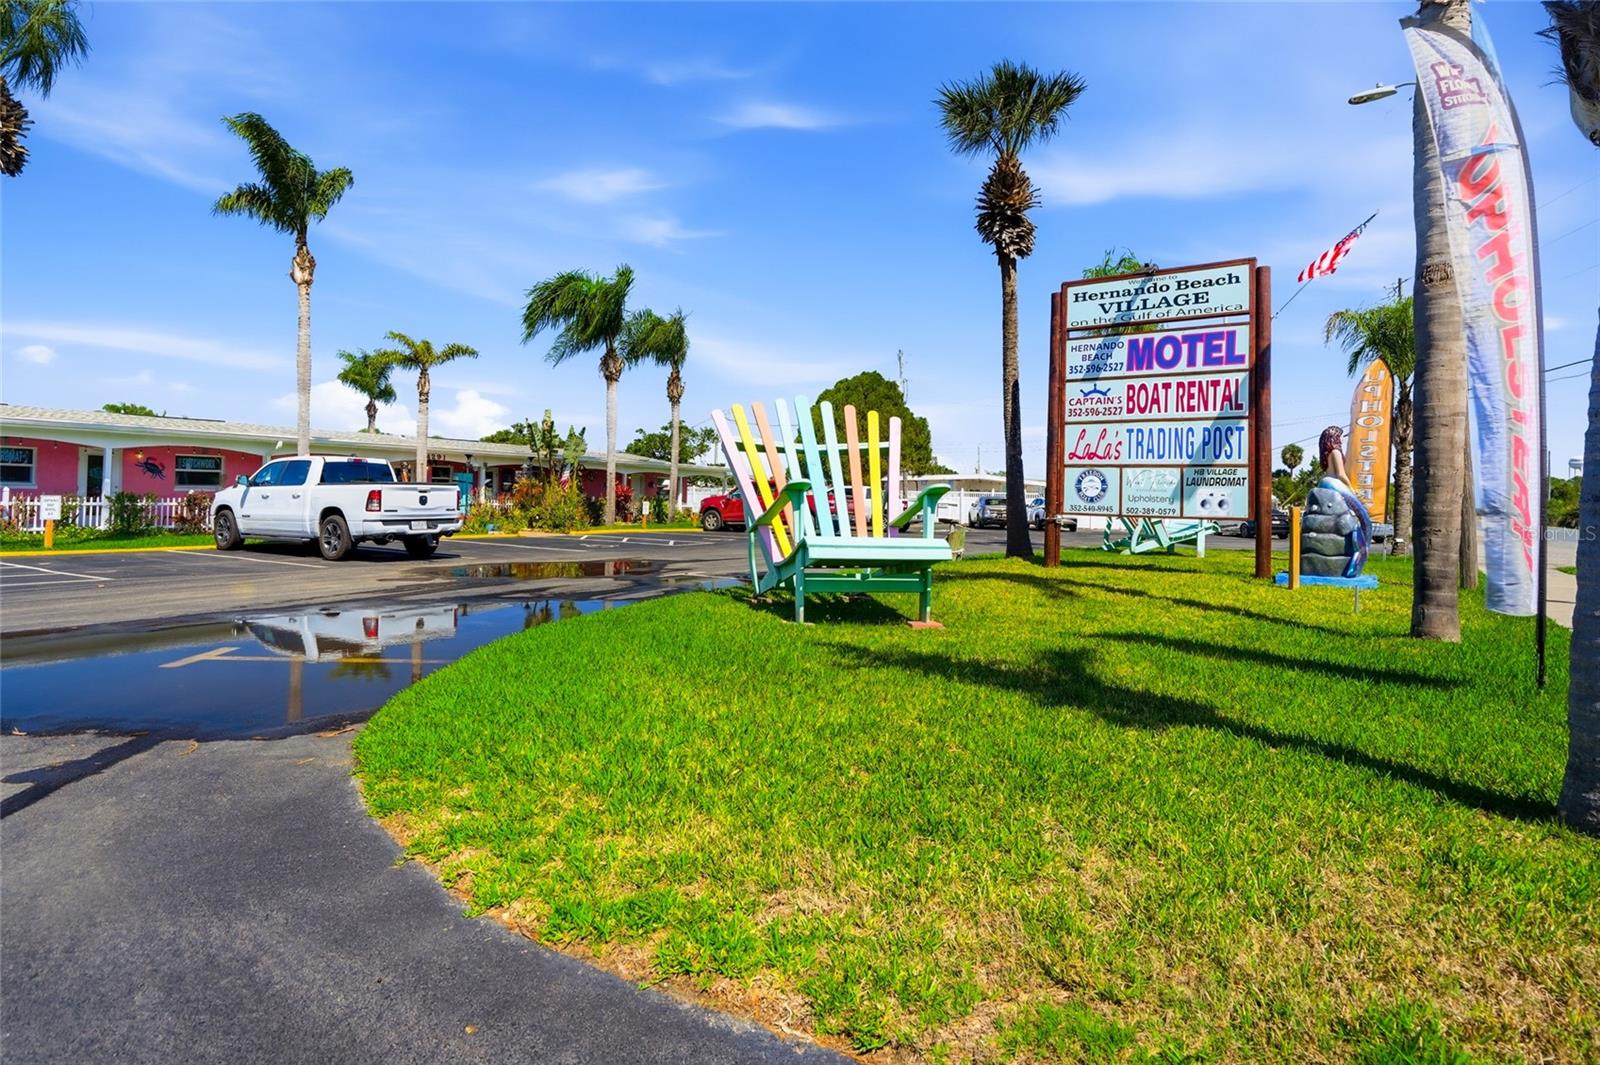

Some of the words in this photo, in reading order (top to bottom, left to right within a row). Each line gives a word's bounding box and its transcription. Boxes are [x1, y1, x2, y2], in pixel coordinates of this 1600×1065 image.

[1073, 281, 1170, 303] Hernando
[1175, 272, 1241, 291] Beach
[1098, 291, 1209, 315] VILLAGE
[1070, 319, 1088, 327] on
[1093, 315, 1117, 324] the
[1120, 311, 1152, 321] Gulf
[1156, 308, 1172, 318] of
[1175, 303, 1243, 316] America
[1070, 341, 1125, 353] HERNANDO
[1126, 329, 1246, 372] MOTEL
[1081, 352, 1113, 362] BEACH
[1068, 396, 1122, 406] CAPTAIN'S
[1126, 381, 1172, 415] BOAT
[1175, 378, 1244, 413] RENTAL
[1126, 426, 1195, 460] TRADING
[1202, 425, 1245, 460] POST
[1193, 468, 1205, 476] HB
[1207, 468, 1238, 476] VILLAGE
[1185, 477, 1247, 487] LAUNDROMAT
[1127, 495, 1175, 505] Upholstery
[1126, 507, 1176, 515] 502-389-0579
